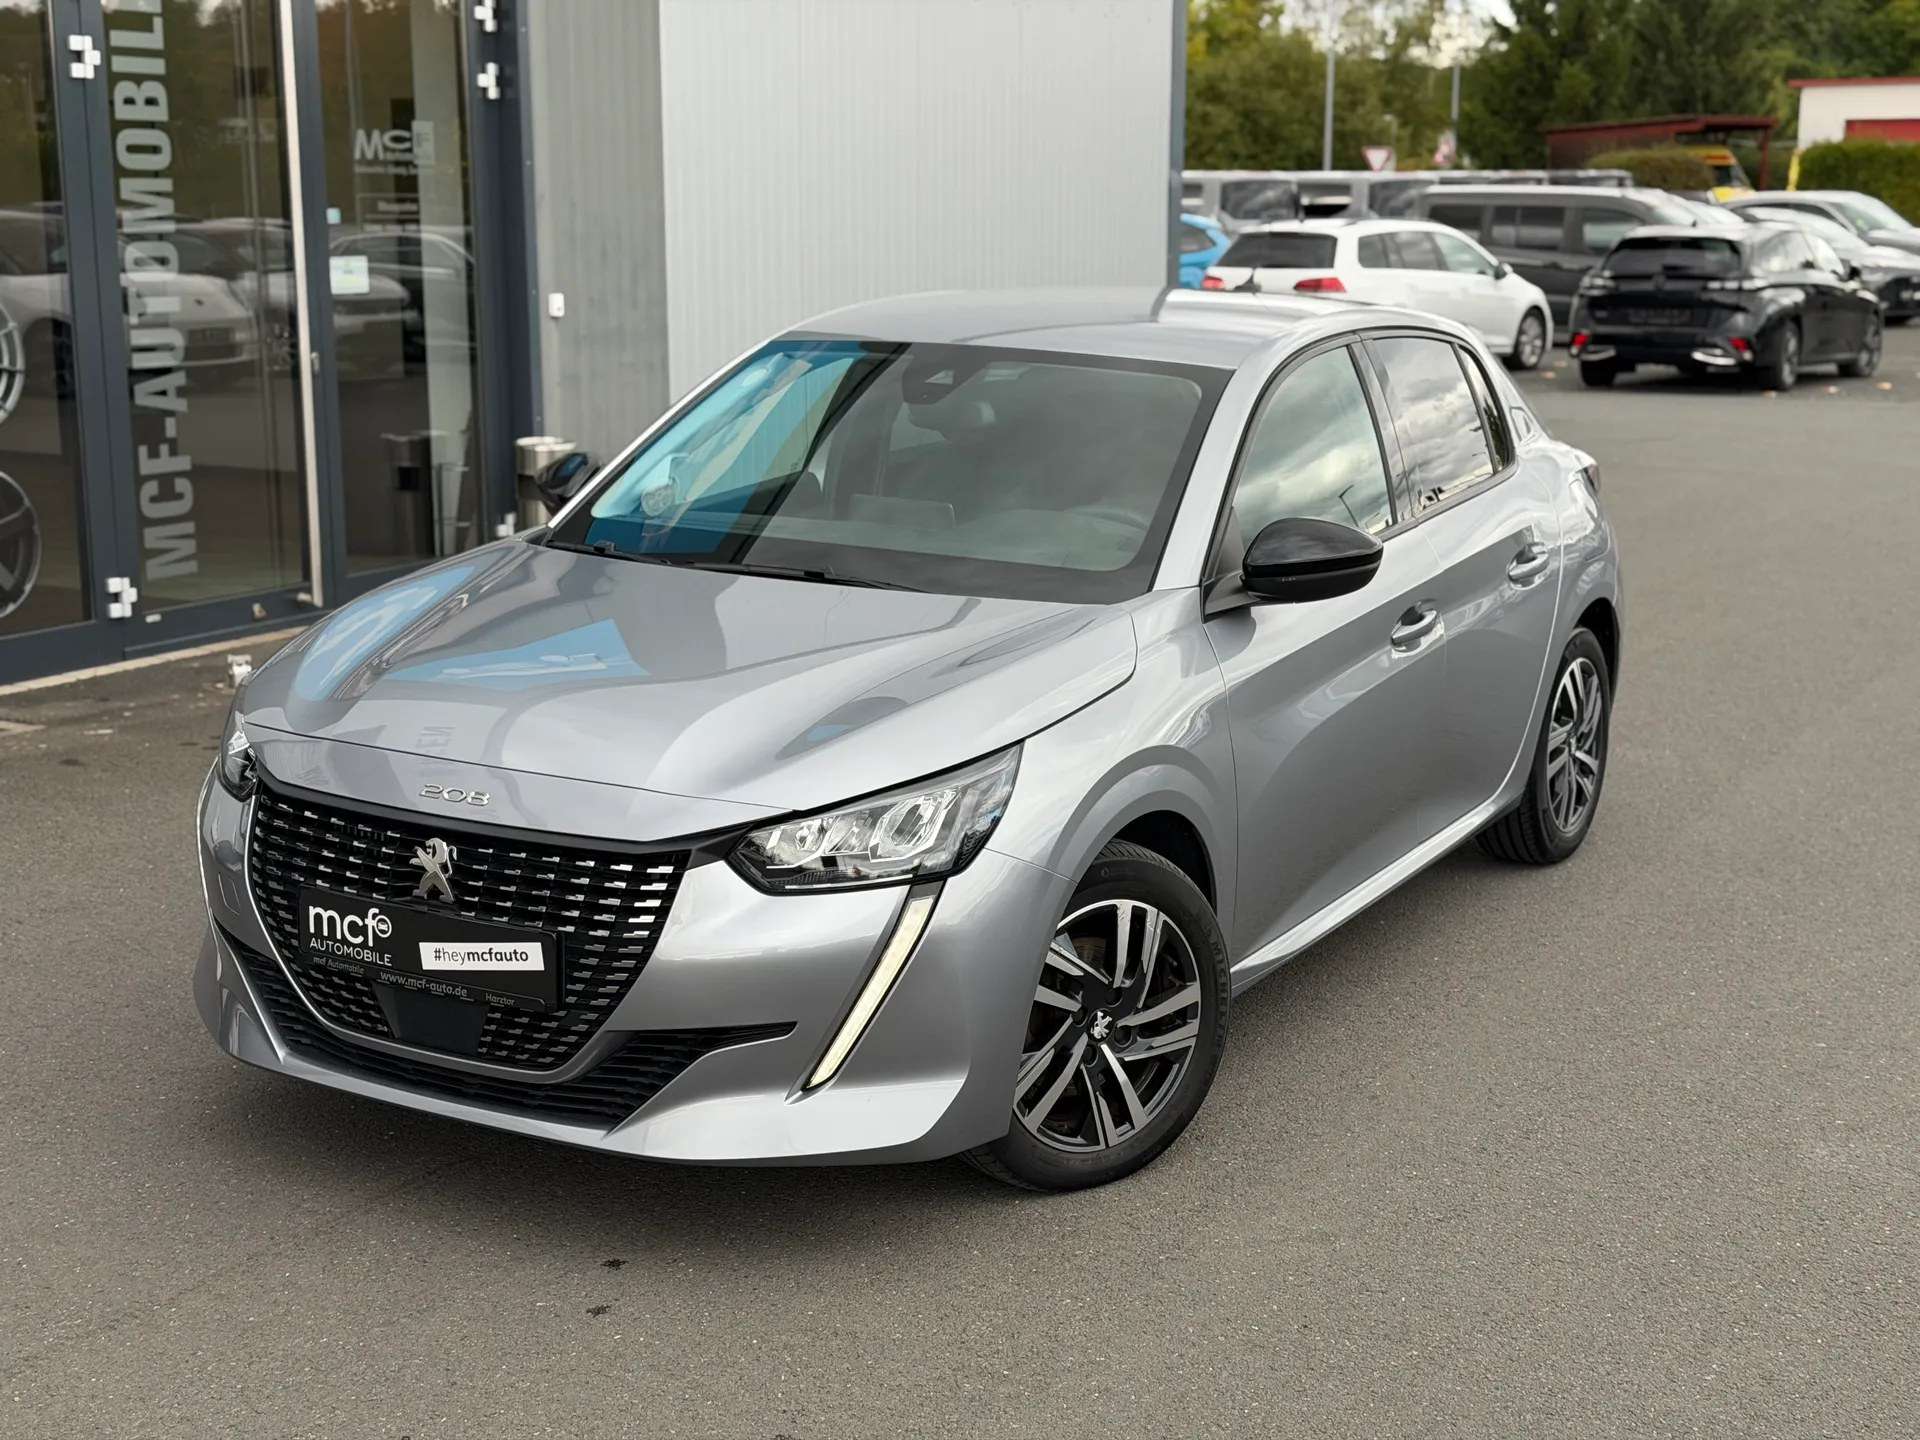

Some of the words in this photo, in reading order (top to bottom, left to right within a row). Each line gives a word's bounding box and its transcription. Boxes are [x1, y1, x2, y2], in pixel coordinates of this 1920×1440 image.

[419, 784, 490, 806] 208
[310, 937, 392, 967] AUTOMOBILE
[433, 947, 529, 966] #heymcfauto
[380, 971, 467, 997] www.mcf-auto.de
[485, 992, 515, 1006] Harztor
